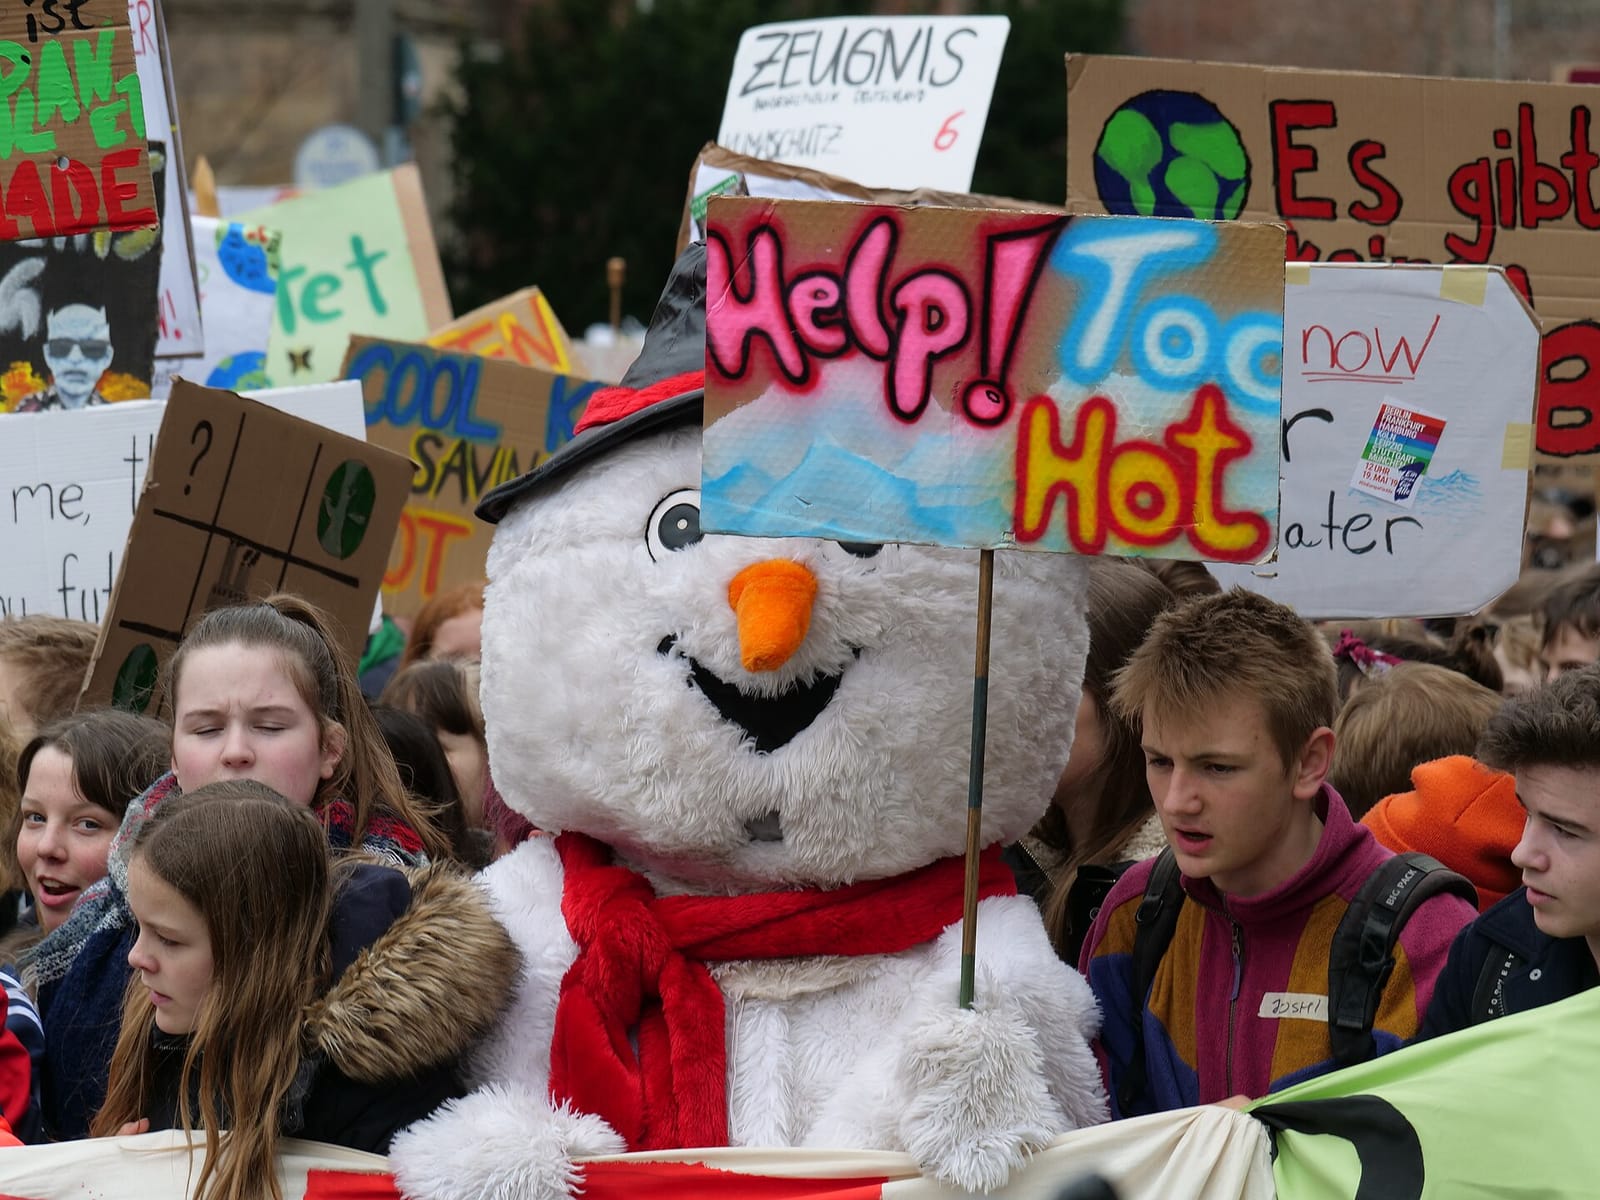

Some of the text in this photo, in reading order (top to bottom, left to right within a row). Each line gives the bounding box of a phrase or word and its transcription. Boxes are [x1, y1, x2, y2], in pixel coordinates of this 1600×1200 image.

[740, 26, 977, 97] ZEUGNIS
[934, 110, 966, 152] 6
[0, 148, 158, 241] ADE
[1269, 99, 1600, 265] Es gibt
[706, 215, 1283, 428] Help! Too
[1302, 314, 1441, 376] now
[347, 343, 502, 440] COOL
[1381, 412, 1426, 433] FRANKFURT
[1384, 405, 1412, 420] BERLIN
[185, 419, 214, 496] ?
[1371, 445, 1417, 465] STUTTGART
[1379, 420, 1418, 440] HAMBURG
[13, 433, 154, 526] me, t
[1014, 382, 1272, 560] Hot
[1373, 464, 1391, 476] UHR
[1373, 473, 1389, 485] MAI
[1397, 869, 1418, 889] PACK
